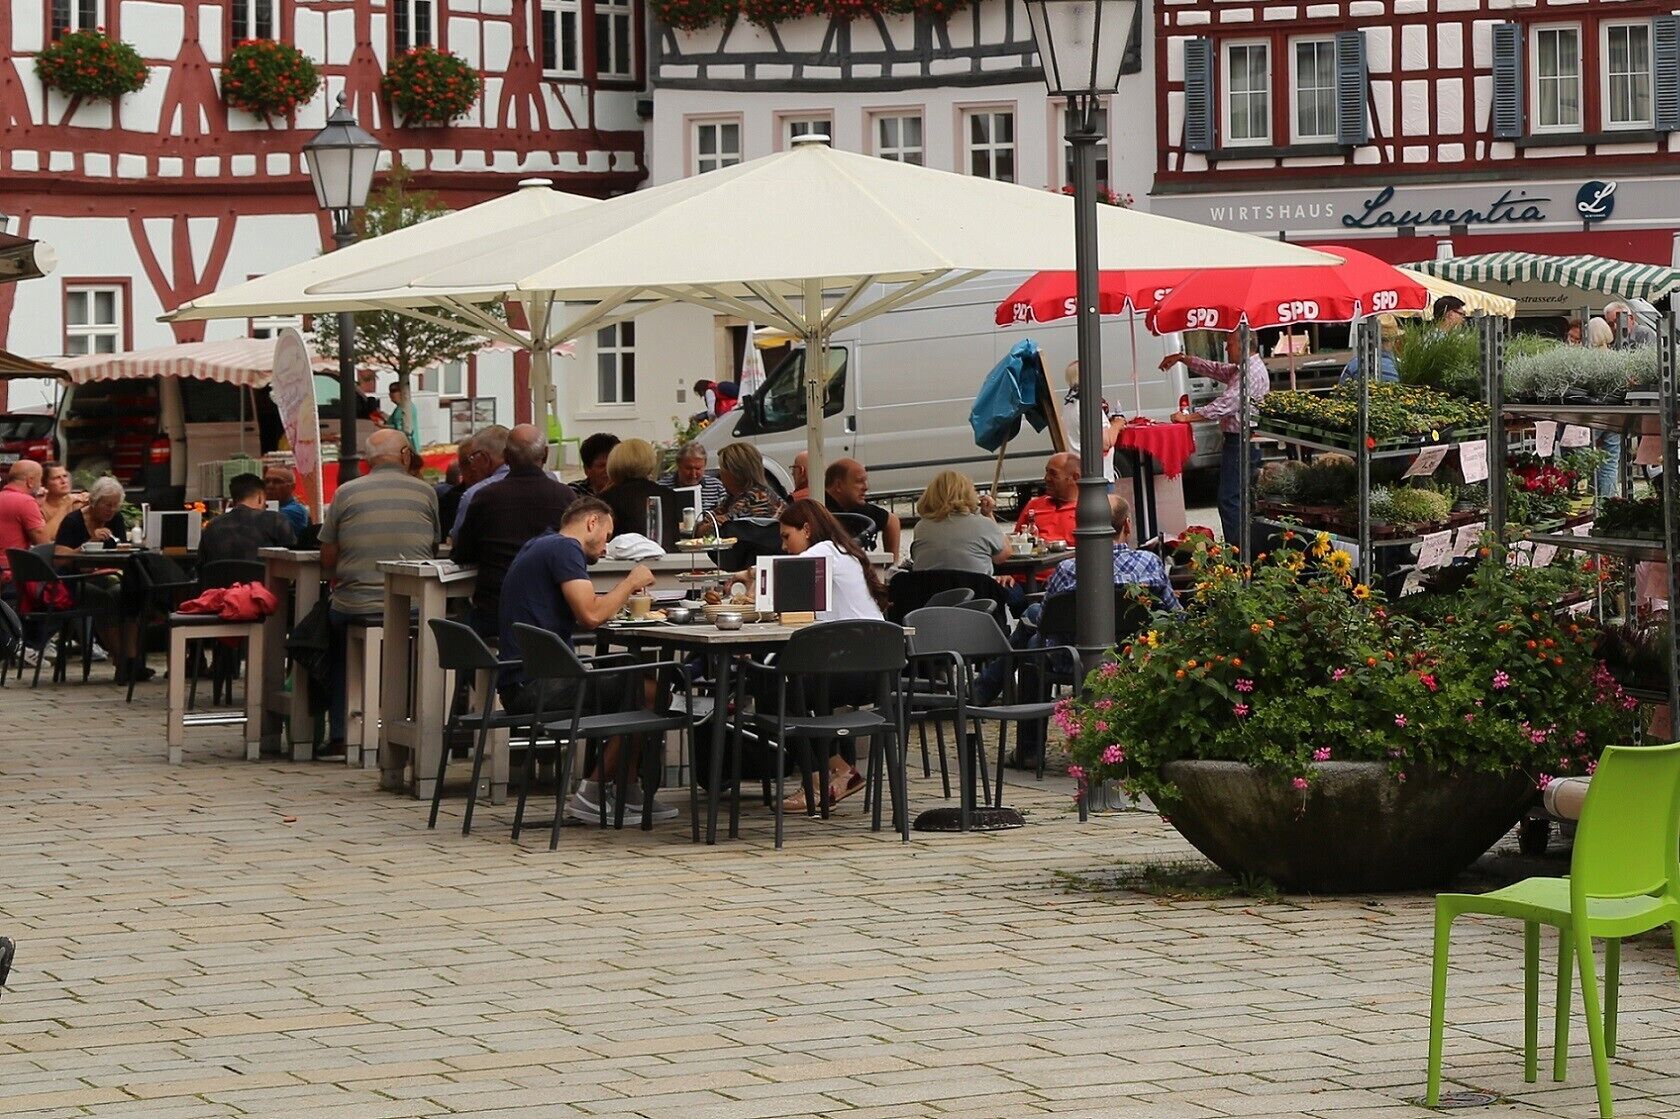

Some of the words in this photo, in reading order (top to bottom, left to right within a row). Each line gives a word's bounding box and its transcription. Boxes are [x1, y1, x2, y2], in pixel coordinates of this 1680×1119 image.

[1210, 203, 1334, 221] WIRTSHAUS
[1341, 185, 1551, 228] Laurentia
[1277, 300, 1319, 323] SPD
[1372, 290, 1398, 311] SPD
[1187, 308, 1219, 328] SPD
